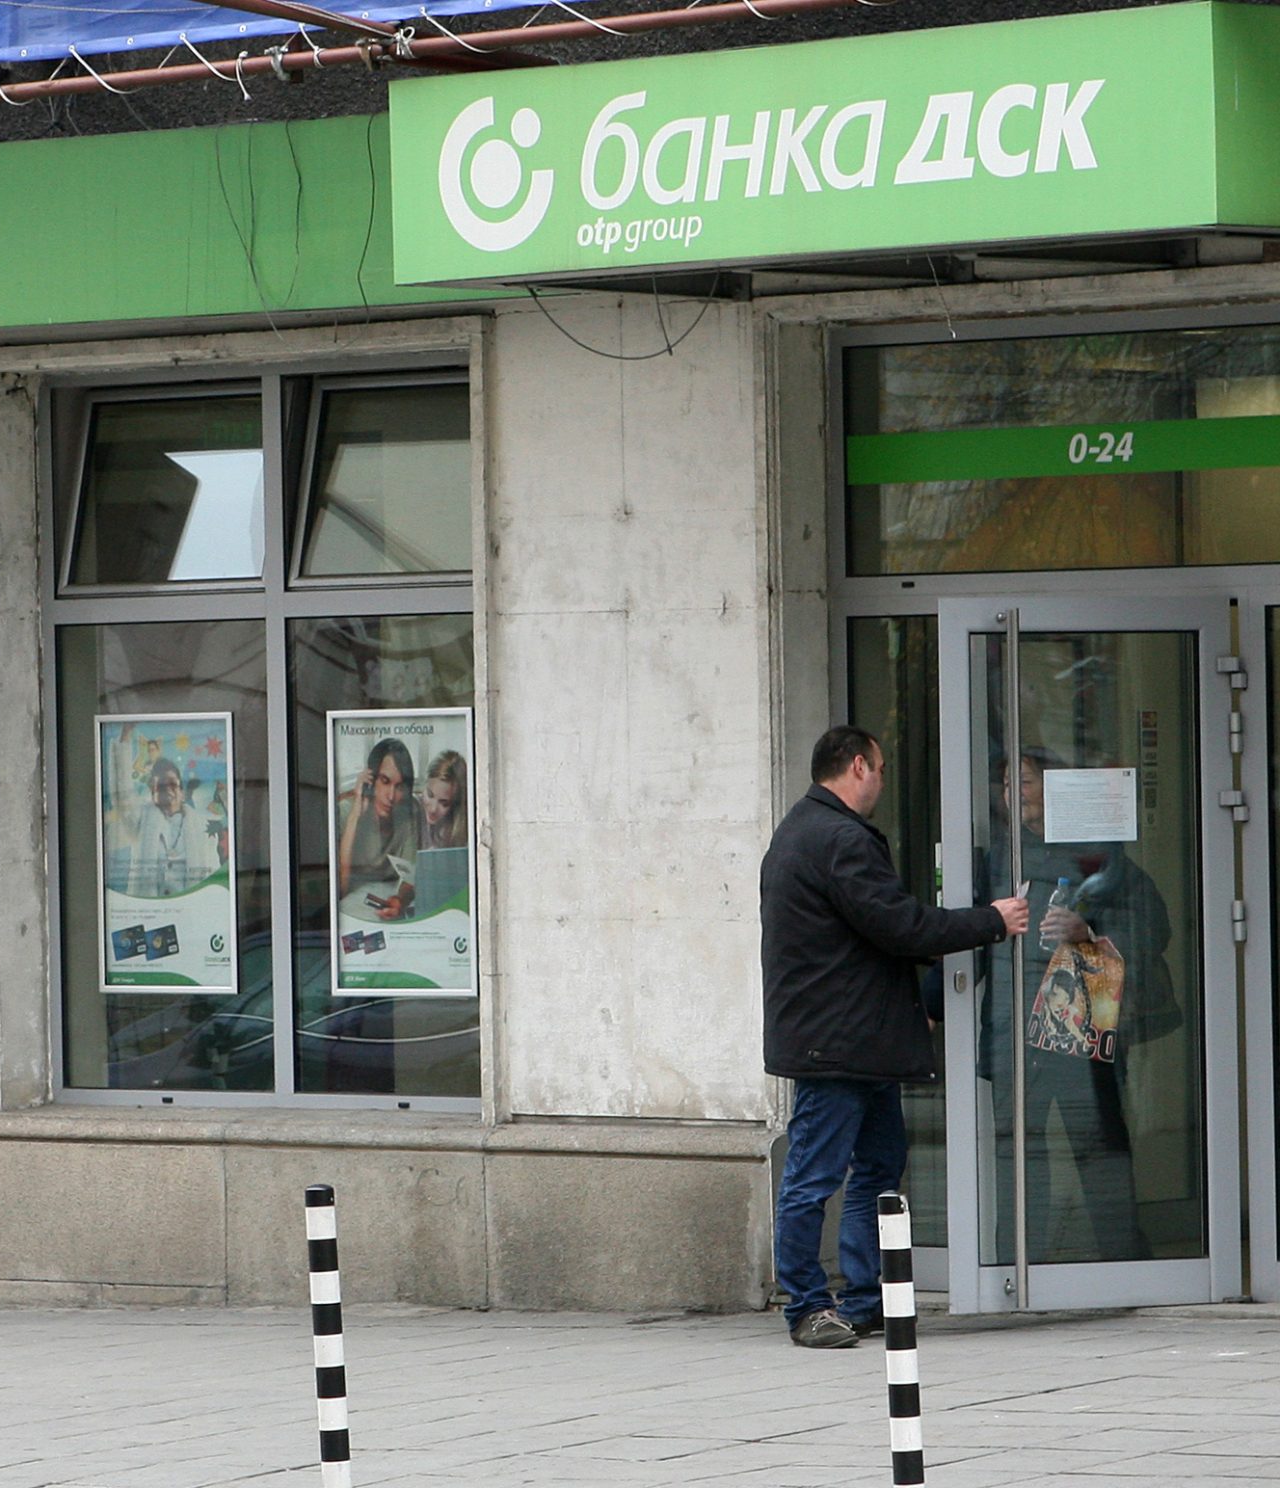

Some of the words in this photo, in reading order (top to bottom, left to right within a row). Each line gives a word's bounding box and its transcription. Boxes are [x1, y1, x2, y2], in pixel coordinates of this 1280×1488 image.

[580, 90, 887, 211] банка
[894, 78, 1106, 186] ДСК
[1068, 431, 1134, 464] 0-24
[340, 724, 392, 738] Максимум
[394, 722, 434, 735] свобода
